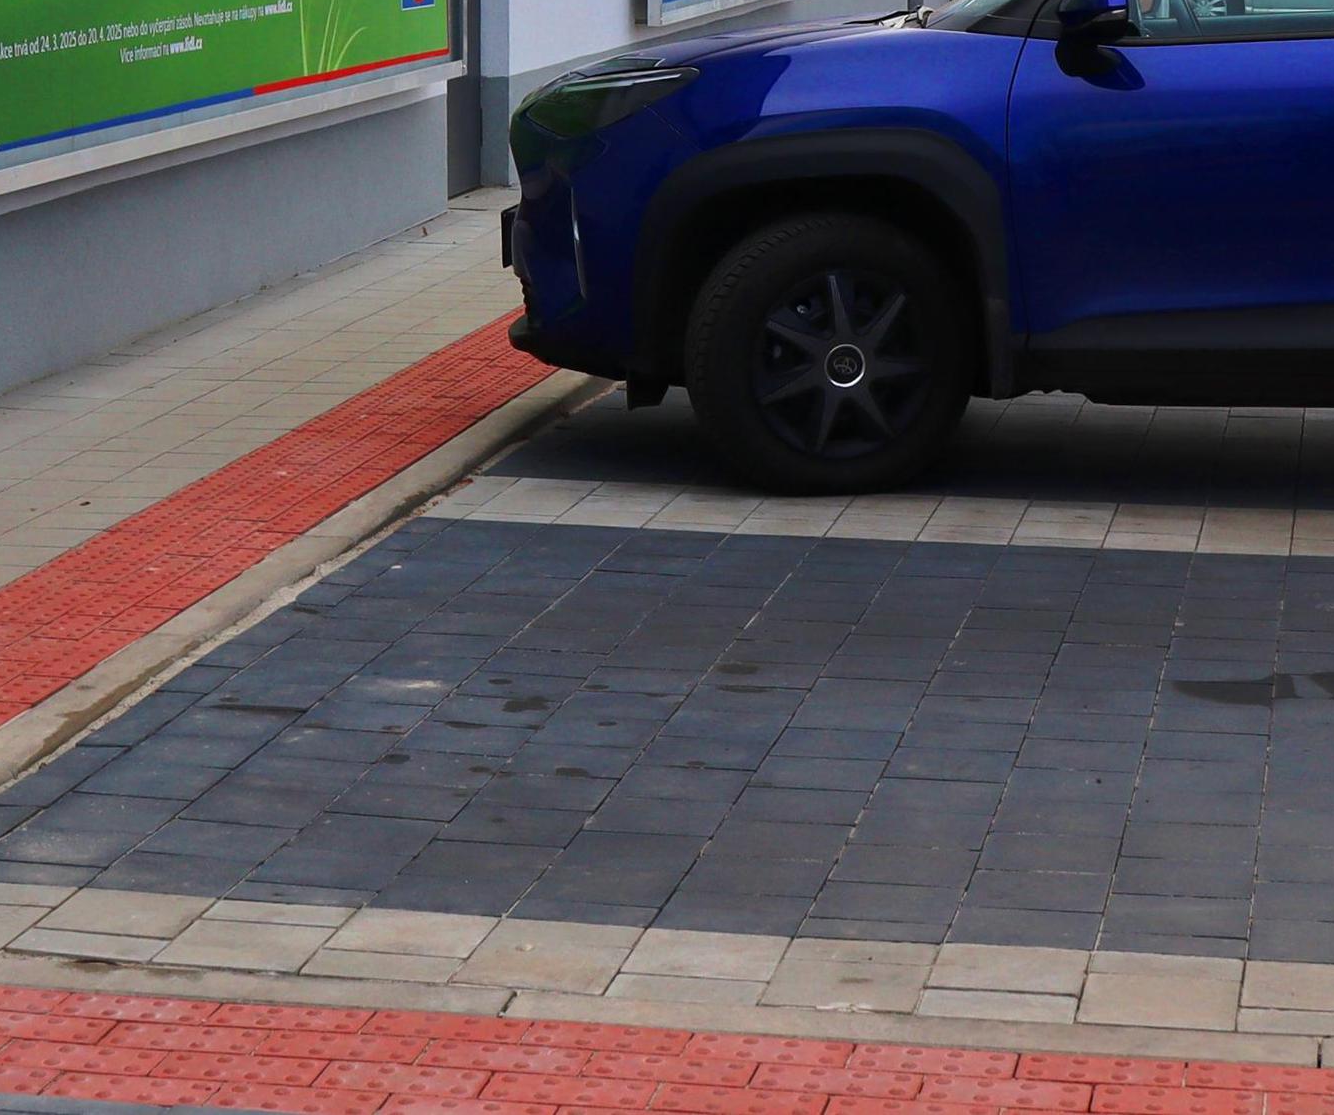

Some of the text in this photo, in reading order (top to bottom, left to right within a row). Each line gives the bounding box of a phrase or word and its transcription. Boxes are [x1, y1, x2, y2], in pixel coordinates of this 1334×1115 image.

[14, 39, 28, 57] trvá
[29, 37, 40, 54] od
[59, 30, 77, 49] 2025
[78, 30, 87, 46] do
[107, 23, 122, 41] 2025
[123, 21, 138, 38] nebo
[140, 20, 148, 36] do
[120, 46, 134, 64] Více
[134, 42, 163, 61] informací
[169, 35, 203, 55] www.lidl.cz
